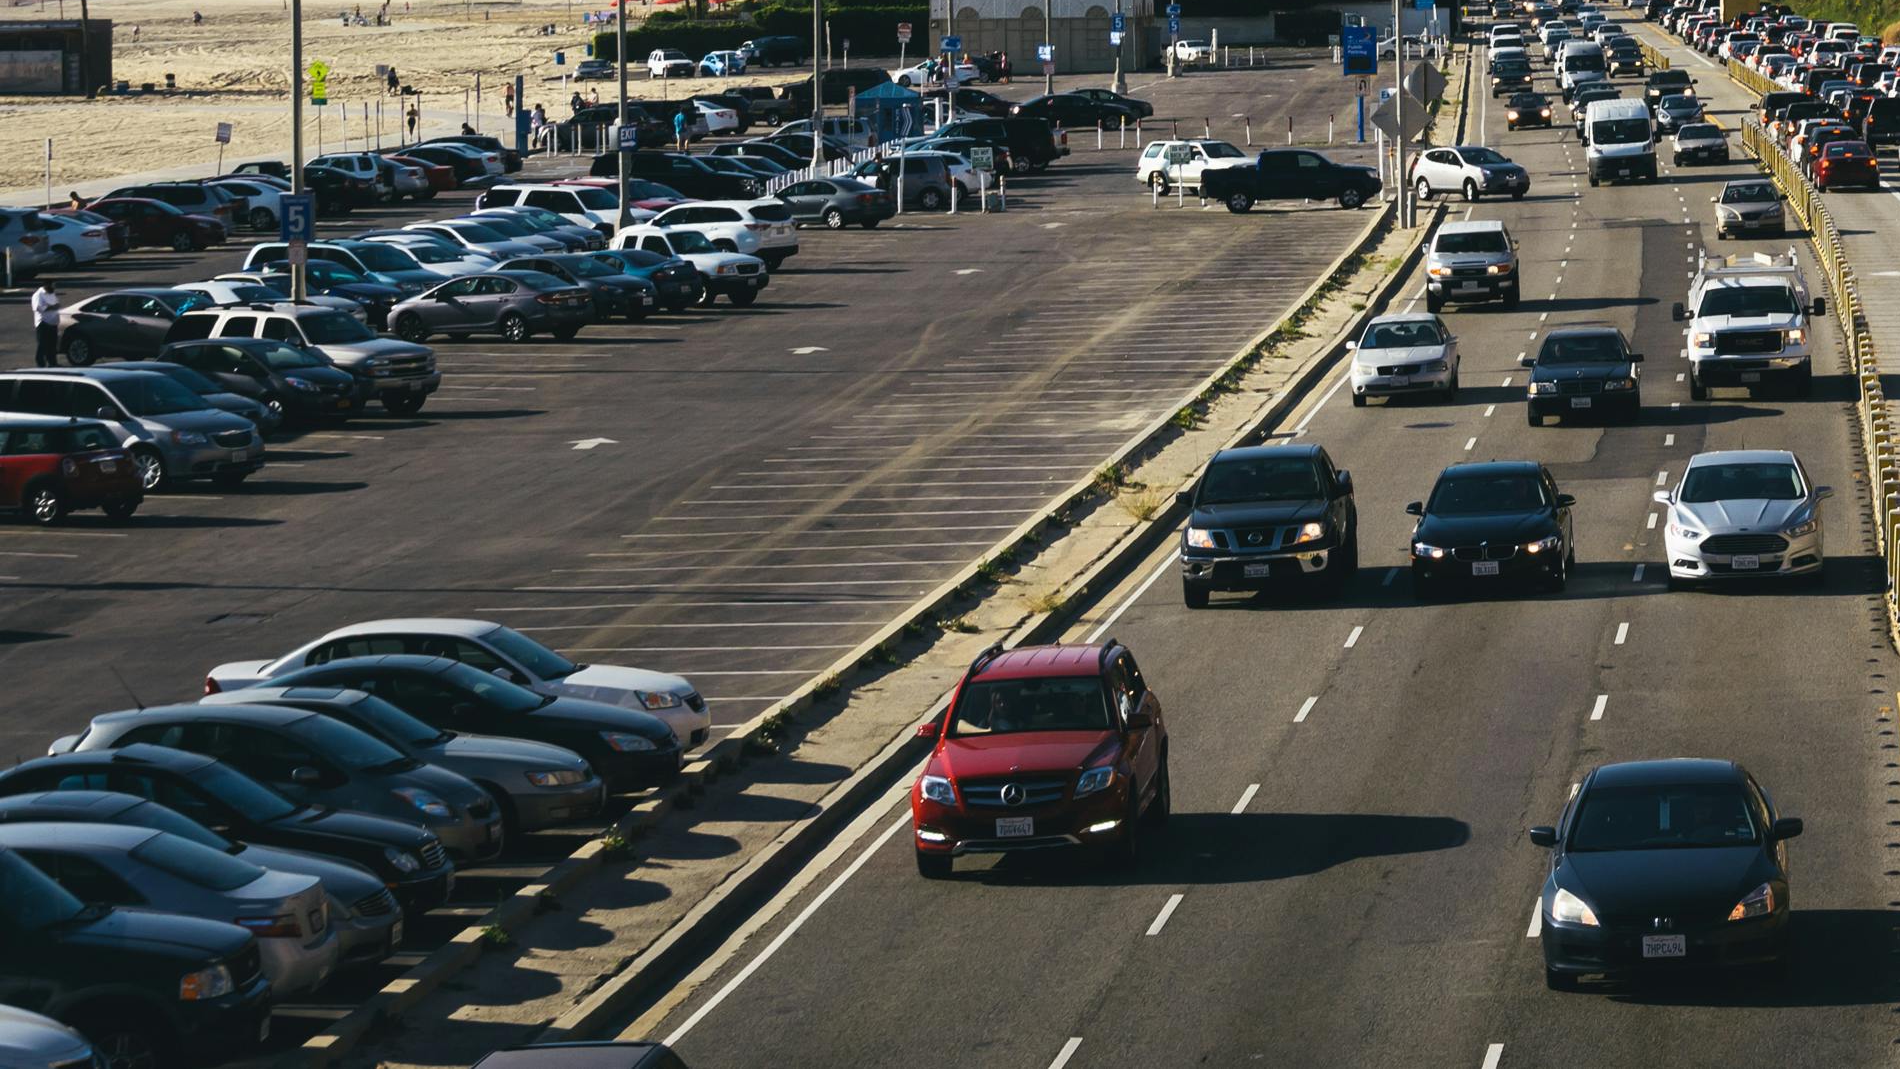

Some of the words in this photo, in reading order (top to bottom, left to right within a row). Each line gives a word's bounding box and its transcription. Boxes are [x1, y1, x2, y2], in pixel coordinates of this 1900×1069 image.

[1115, 17, 1122, 29] 5
[1170, 20, 1178, 31] 5
[620, 128, 636, 140] EXIT
[289, 206, 305, 232] 5
